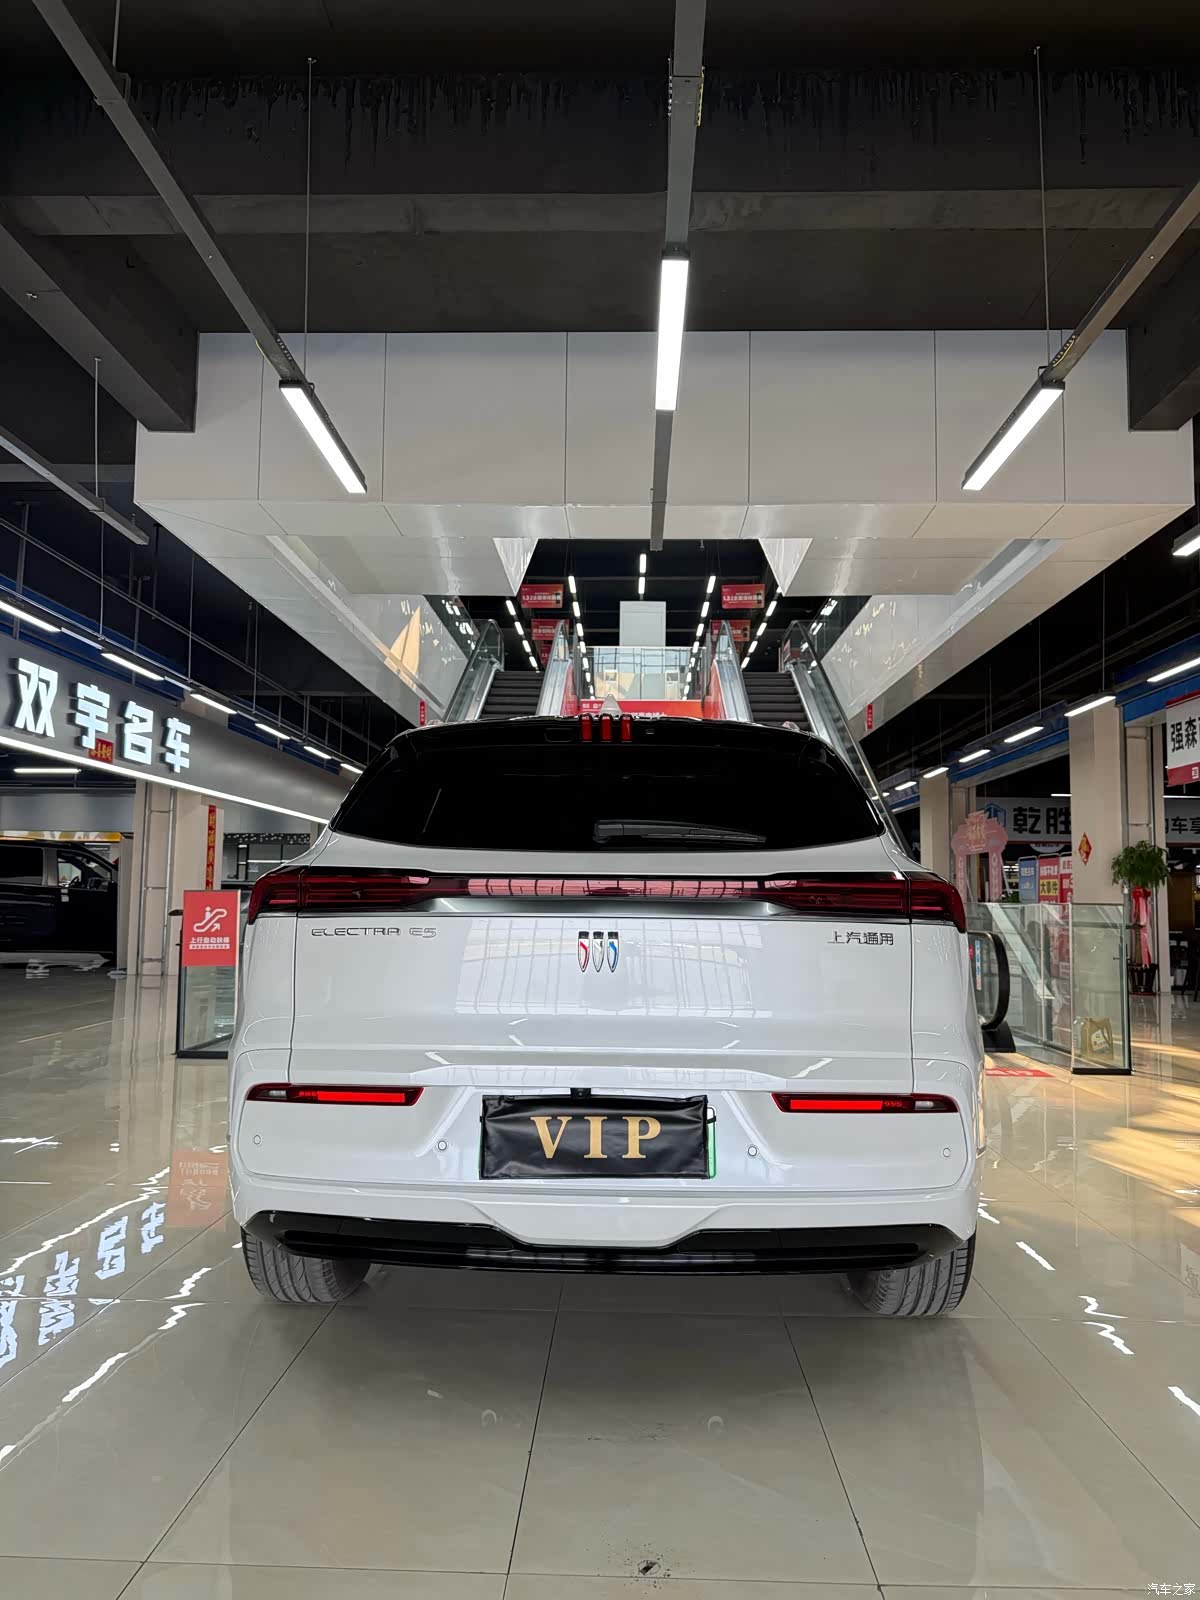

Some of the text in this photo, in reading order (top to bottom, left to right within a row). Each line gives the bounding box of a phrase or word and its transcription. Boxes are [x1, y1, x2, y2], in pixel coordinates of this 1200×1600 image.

[14, 657, 192, 774] 双宇名车
[1013, 806, 1071, 835] 乾胜
[311, 927, 437, 939] ELECTRA E5
[827, 930, 894, 946] 上汽通用
[530, 1116, 662, 1159] VIP
